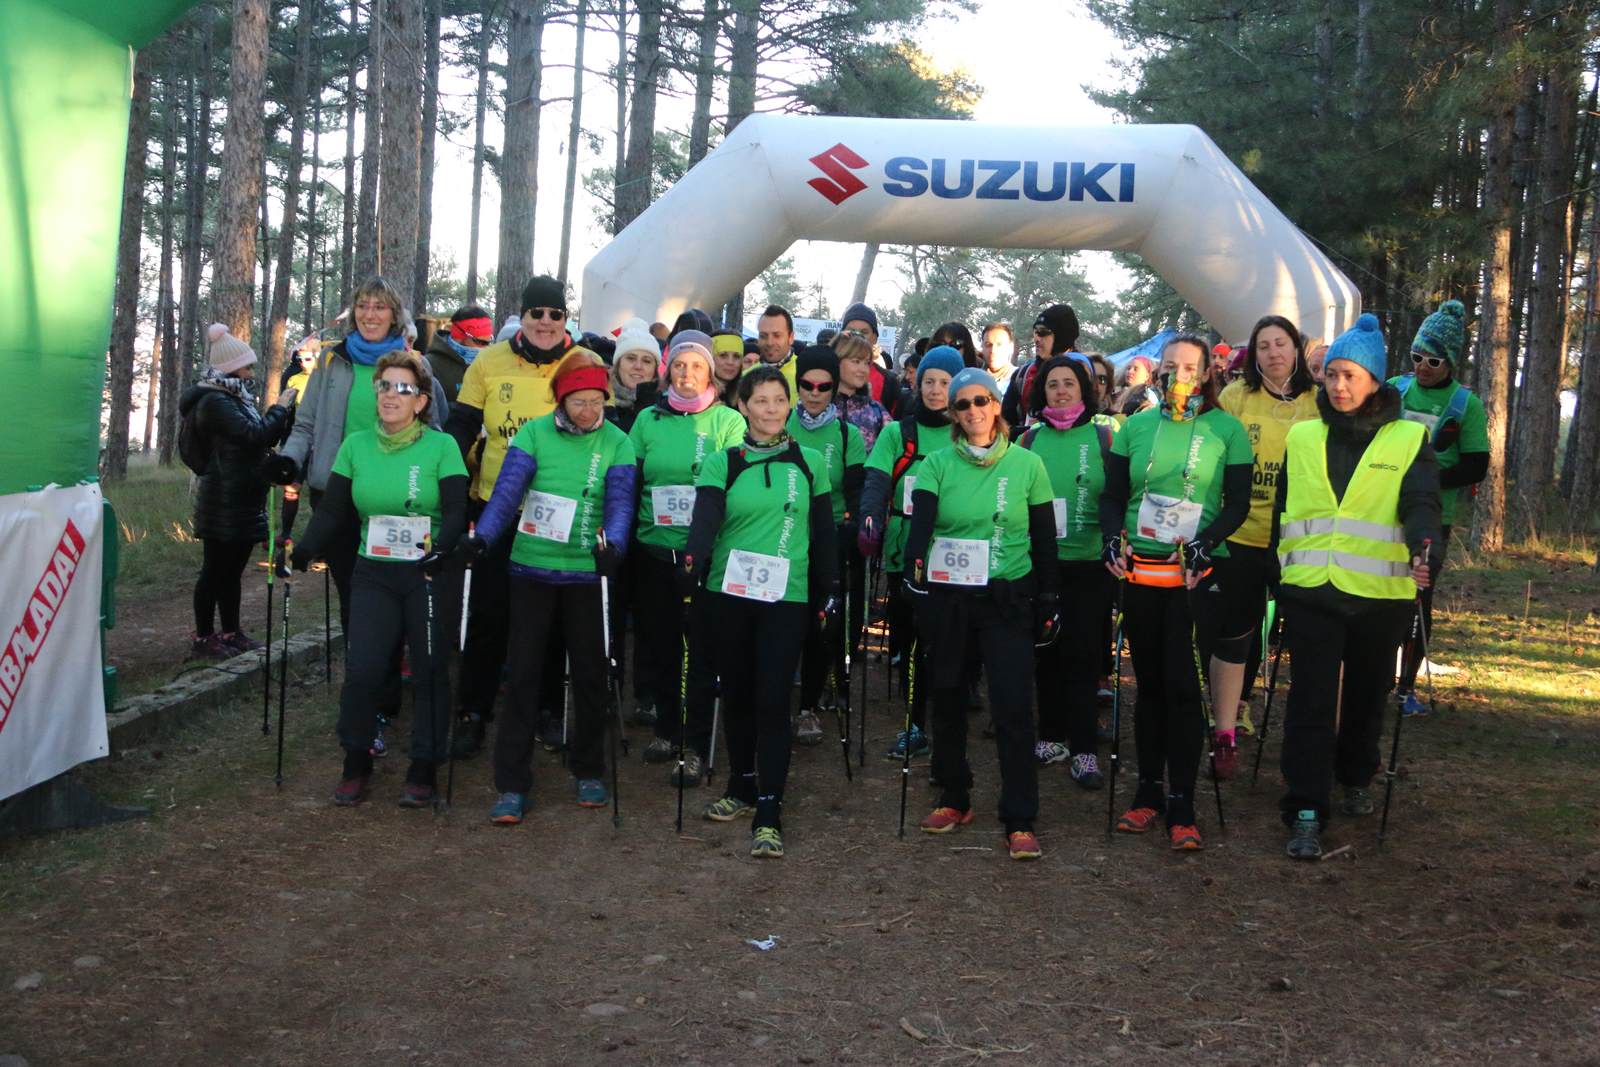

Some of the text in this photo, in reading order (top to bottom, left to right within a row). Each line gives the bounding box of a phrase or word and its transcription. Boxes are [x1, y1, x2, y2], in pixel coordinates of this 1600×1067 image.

[882, 156, 1135, 202] SUZUKI
[667, 497, 690, 511] 56
[534, 505, 556, 522] 67
[1153, 509, 1180, 528] 53
[385, 528, 412, 543] 58
[944, 552, 969, 568] 66
[745, 566, 770, 584] 13
[0, 530, 80, 719] BALADA!
